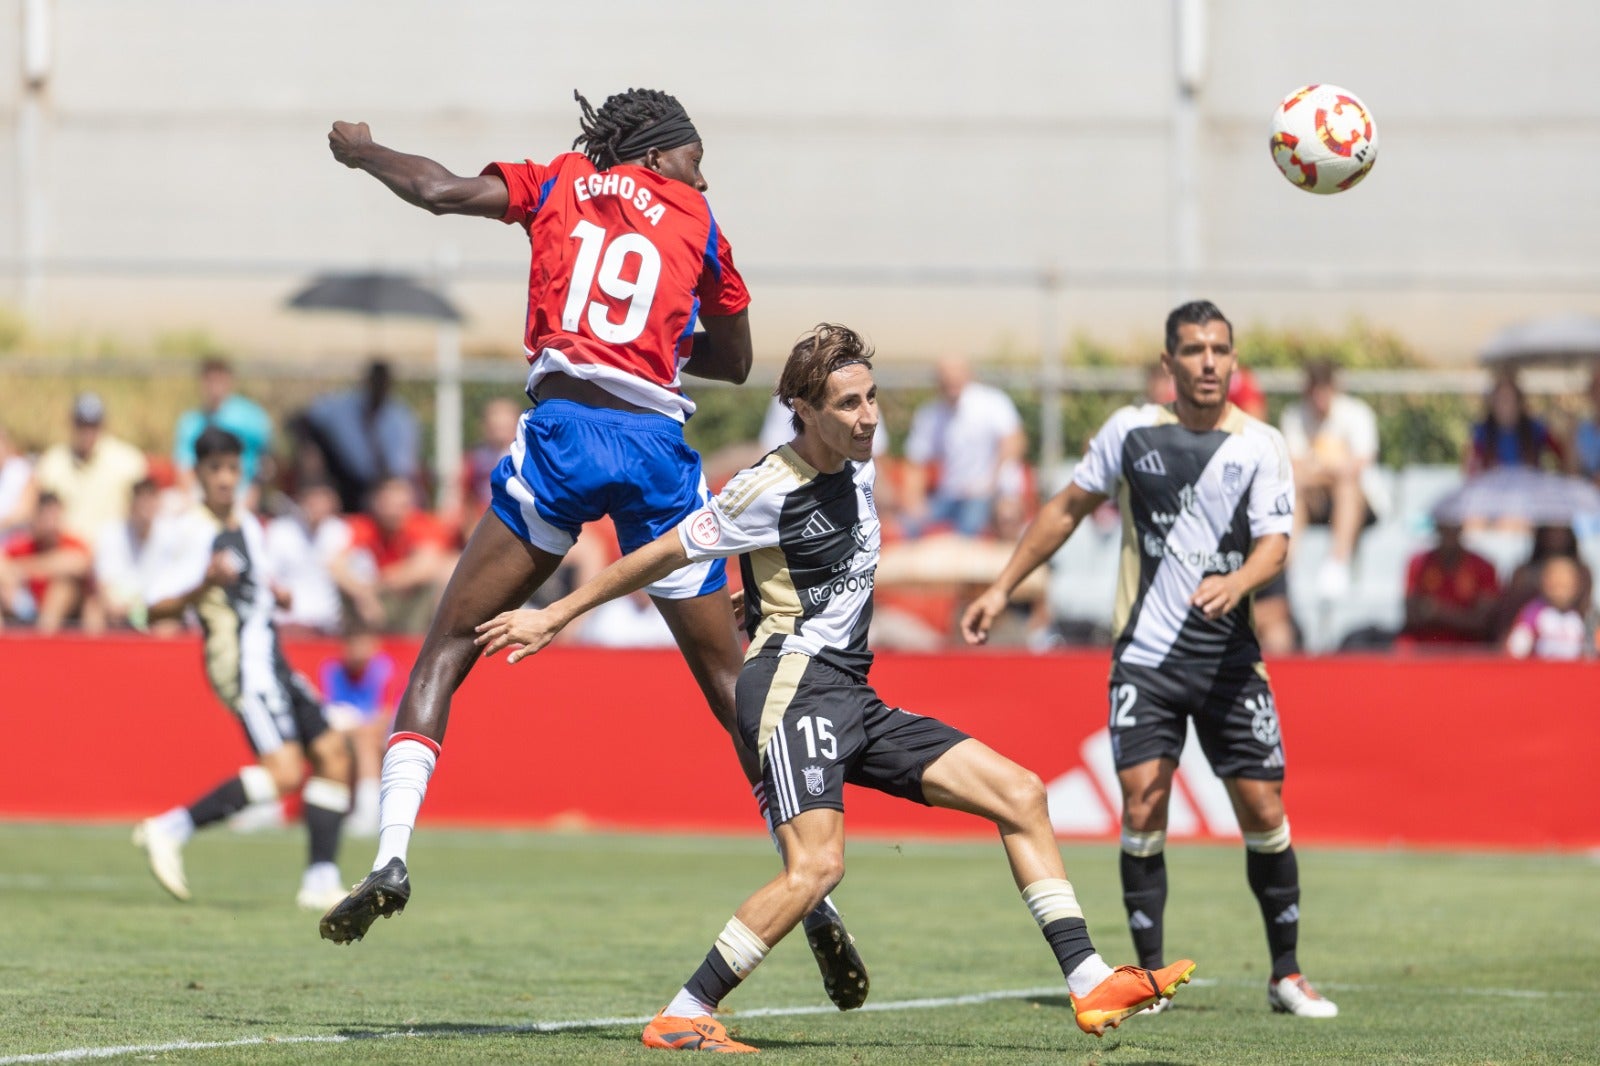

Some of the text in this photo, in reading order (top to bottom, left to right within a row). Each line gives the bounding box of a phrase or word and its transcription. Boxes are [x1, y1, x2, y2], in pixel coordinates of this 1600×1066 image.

[574, 173, 666, 226] EGHOSA
[562, 219, 662, 344] 19
[1110, 683, 1137, 727] 12
[796, 715, 838, 760] 15
